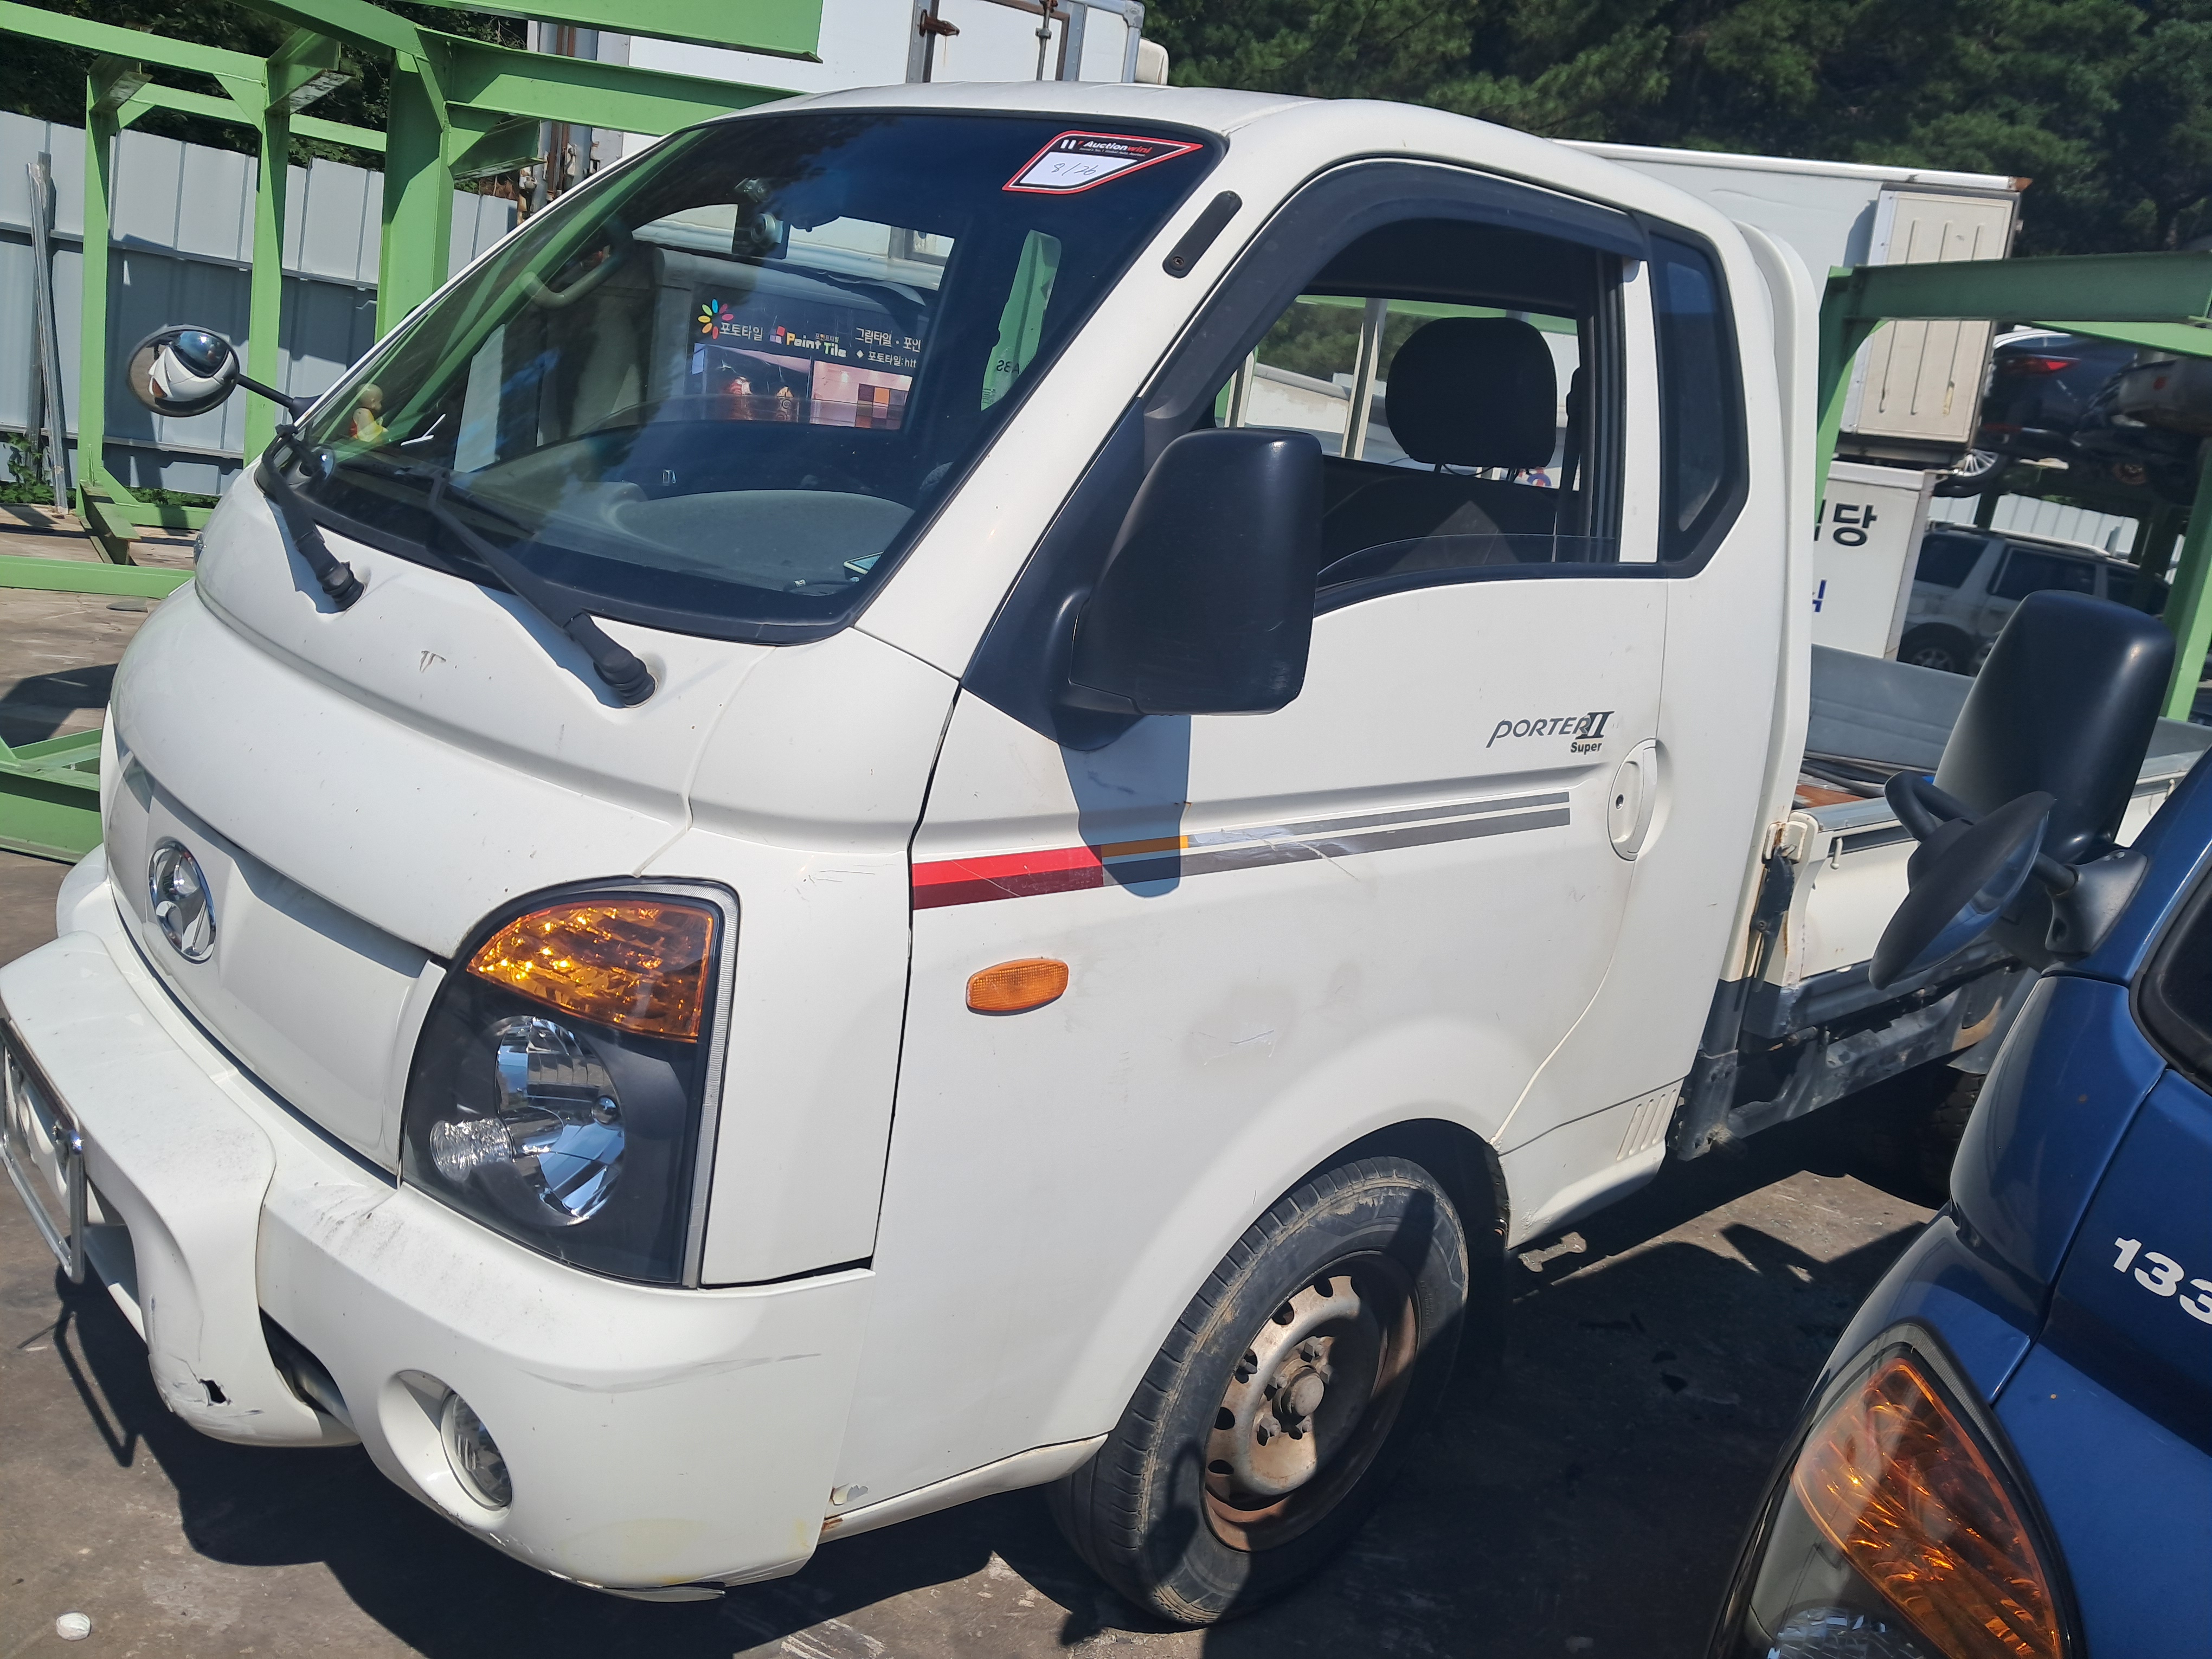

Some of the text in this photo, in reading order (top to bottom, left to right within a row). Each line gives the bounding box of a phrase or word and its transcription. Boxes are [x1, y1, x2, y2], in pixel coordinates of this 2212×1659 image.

[719, 321, 763, 342] 포토타일
[854, 326, 892, 348] 그림타일
[786, 331, 847, 358] Paint Tile
[1570, 741, 1603, 755] Super
[2113, 1236, 2212, 1326] 133
